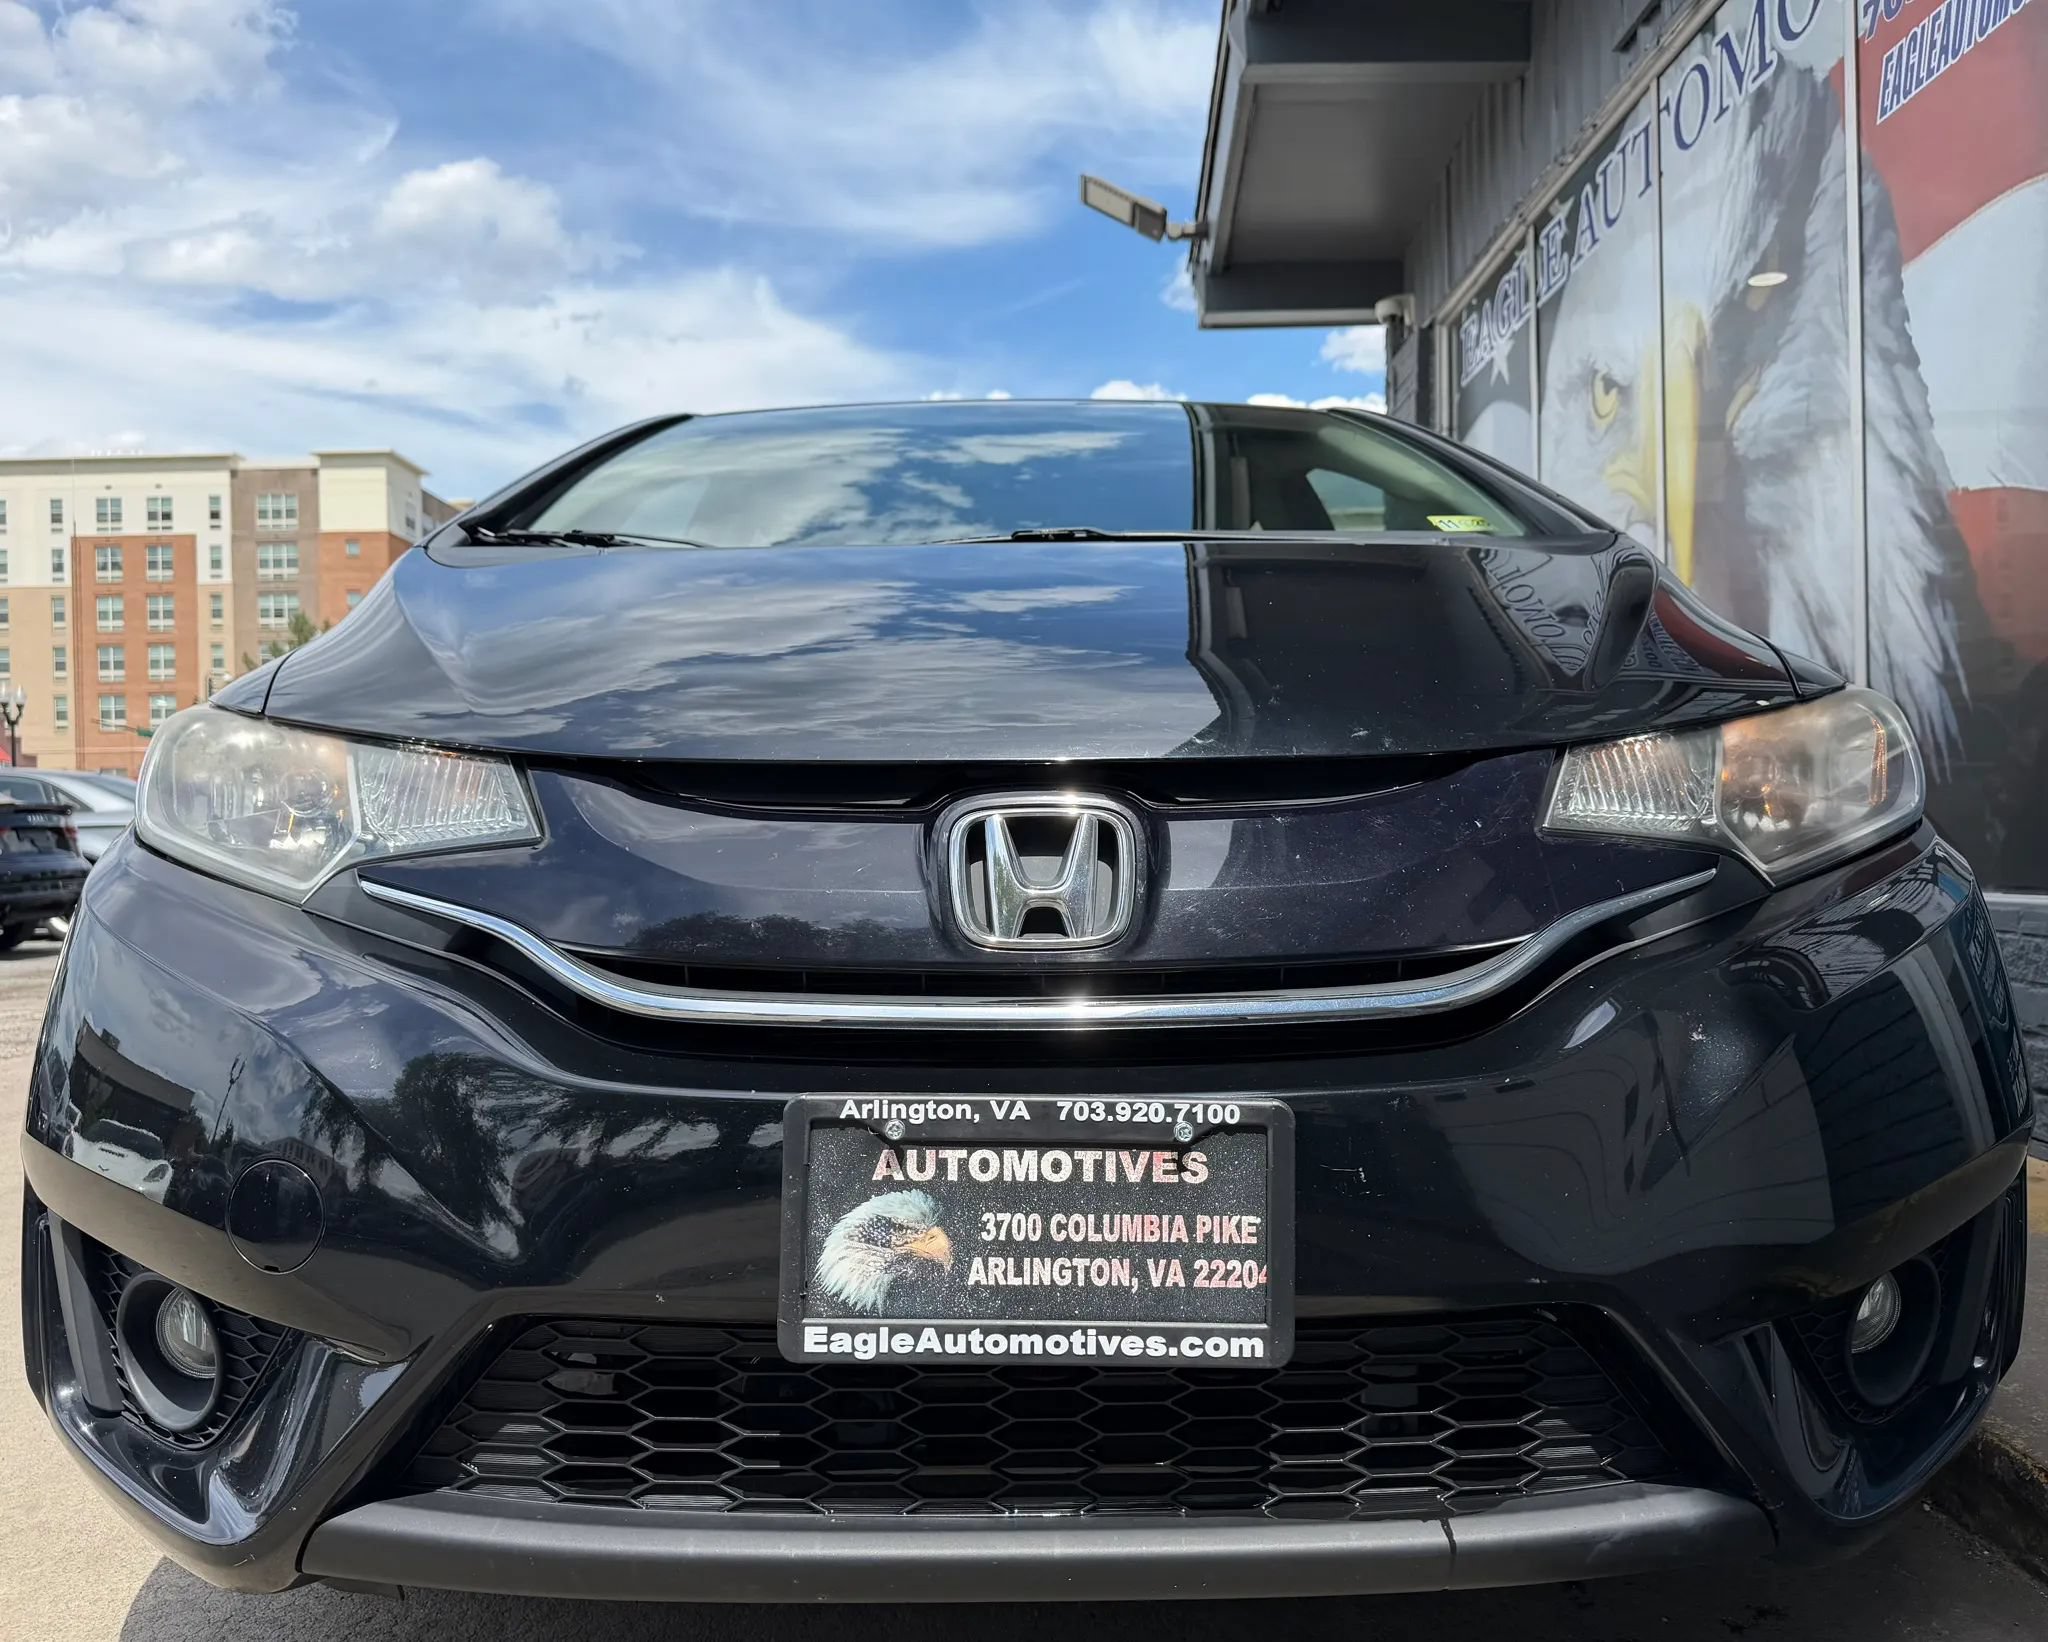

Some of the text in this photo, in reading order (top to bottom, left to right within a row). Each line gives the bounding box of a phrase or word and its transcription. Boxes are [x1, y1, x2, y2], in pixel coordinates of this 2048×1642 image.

[840, 1099, 1241, 1125] Arlington, VA 703.920.7100
[872, 1149, 1209, 1184] AUTOMOTIVES
[981, 1212, 1261, 1244] 3700 COLUMBIA PIKE
[968, 1257, 1138, 1294] ARLINGTON,
[1147, 1258, 1186, 1288] VA
[803, 1326, 1264, 1360] EagleAutomotives.com
